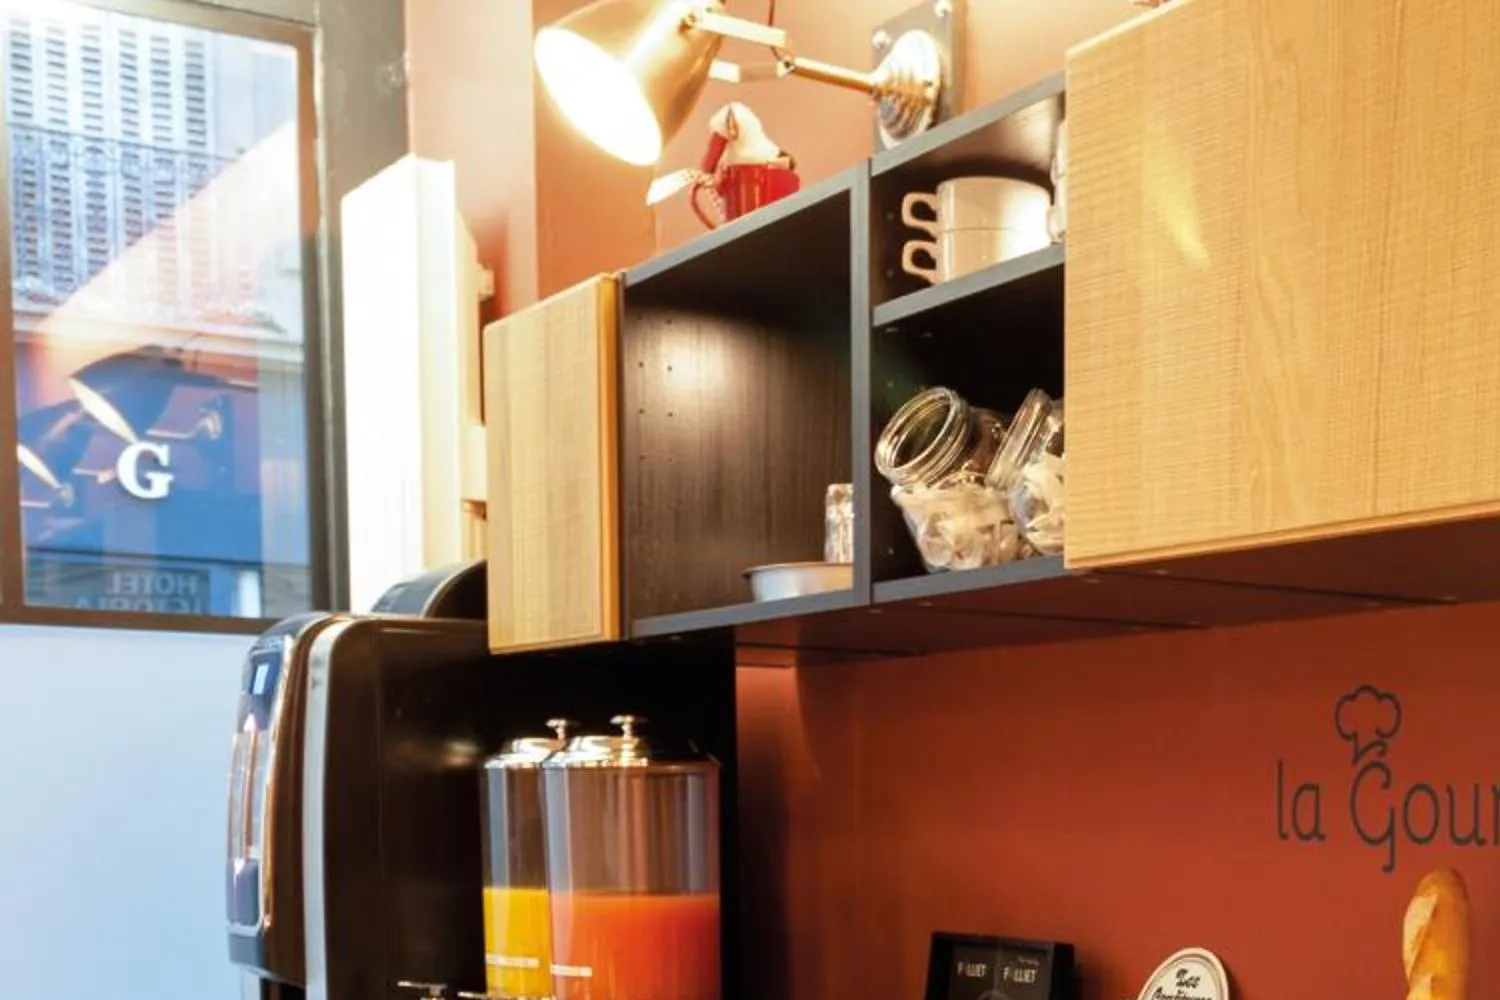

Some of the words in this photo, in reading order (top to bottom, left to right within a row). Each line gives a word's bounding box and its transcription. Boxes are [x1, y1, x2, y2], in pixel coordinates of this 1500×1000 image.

[117, 441, 174, 499] G
[1276, 760, 1326, 841] la
[1176, 968, 1200, 988] Les
